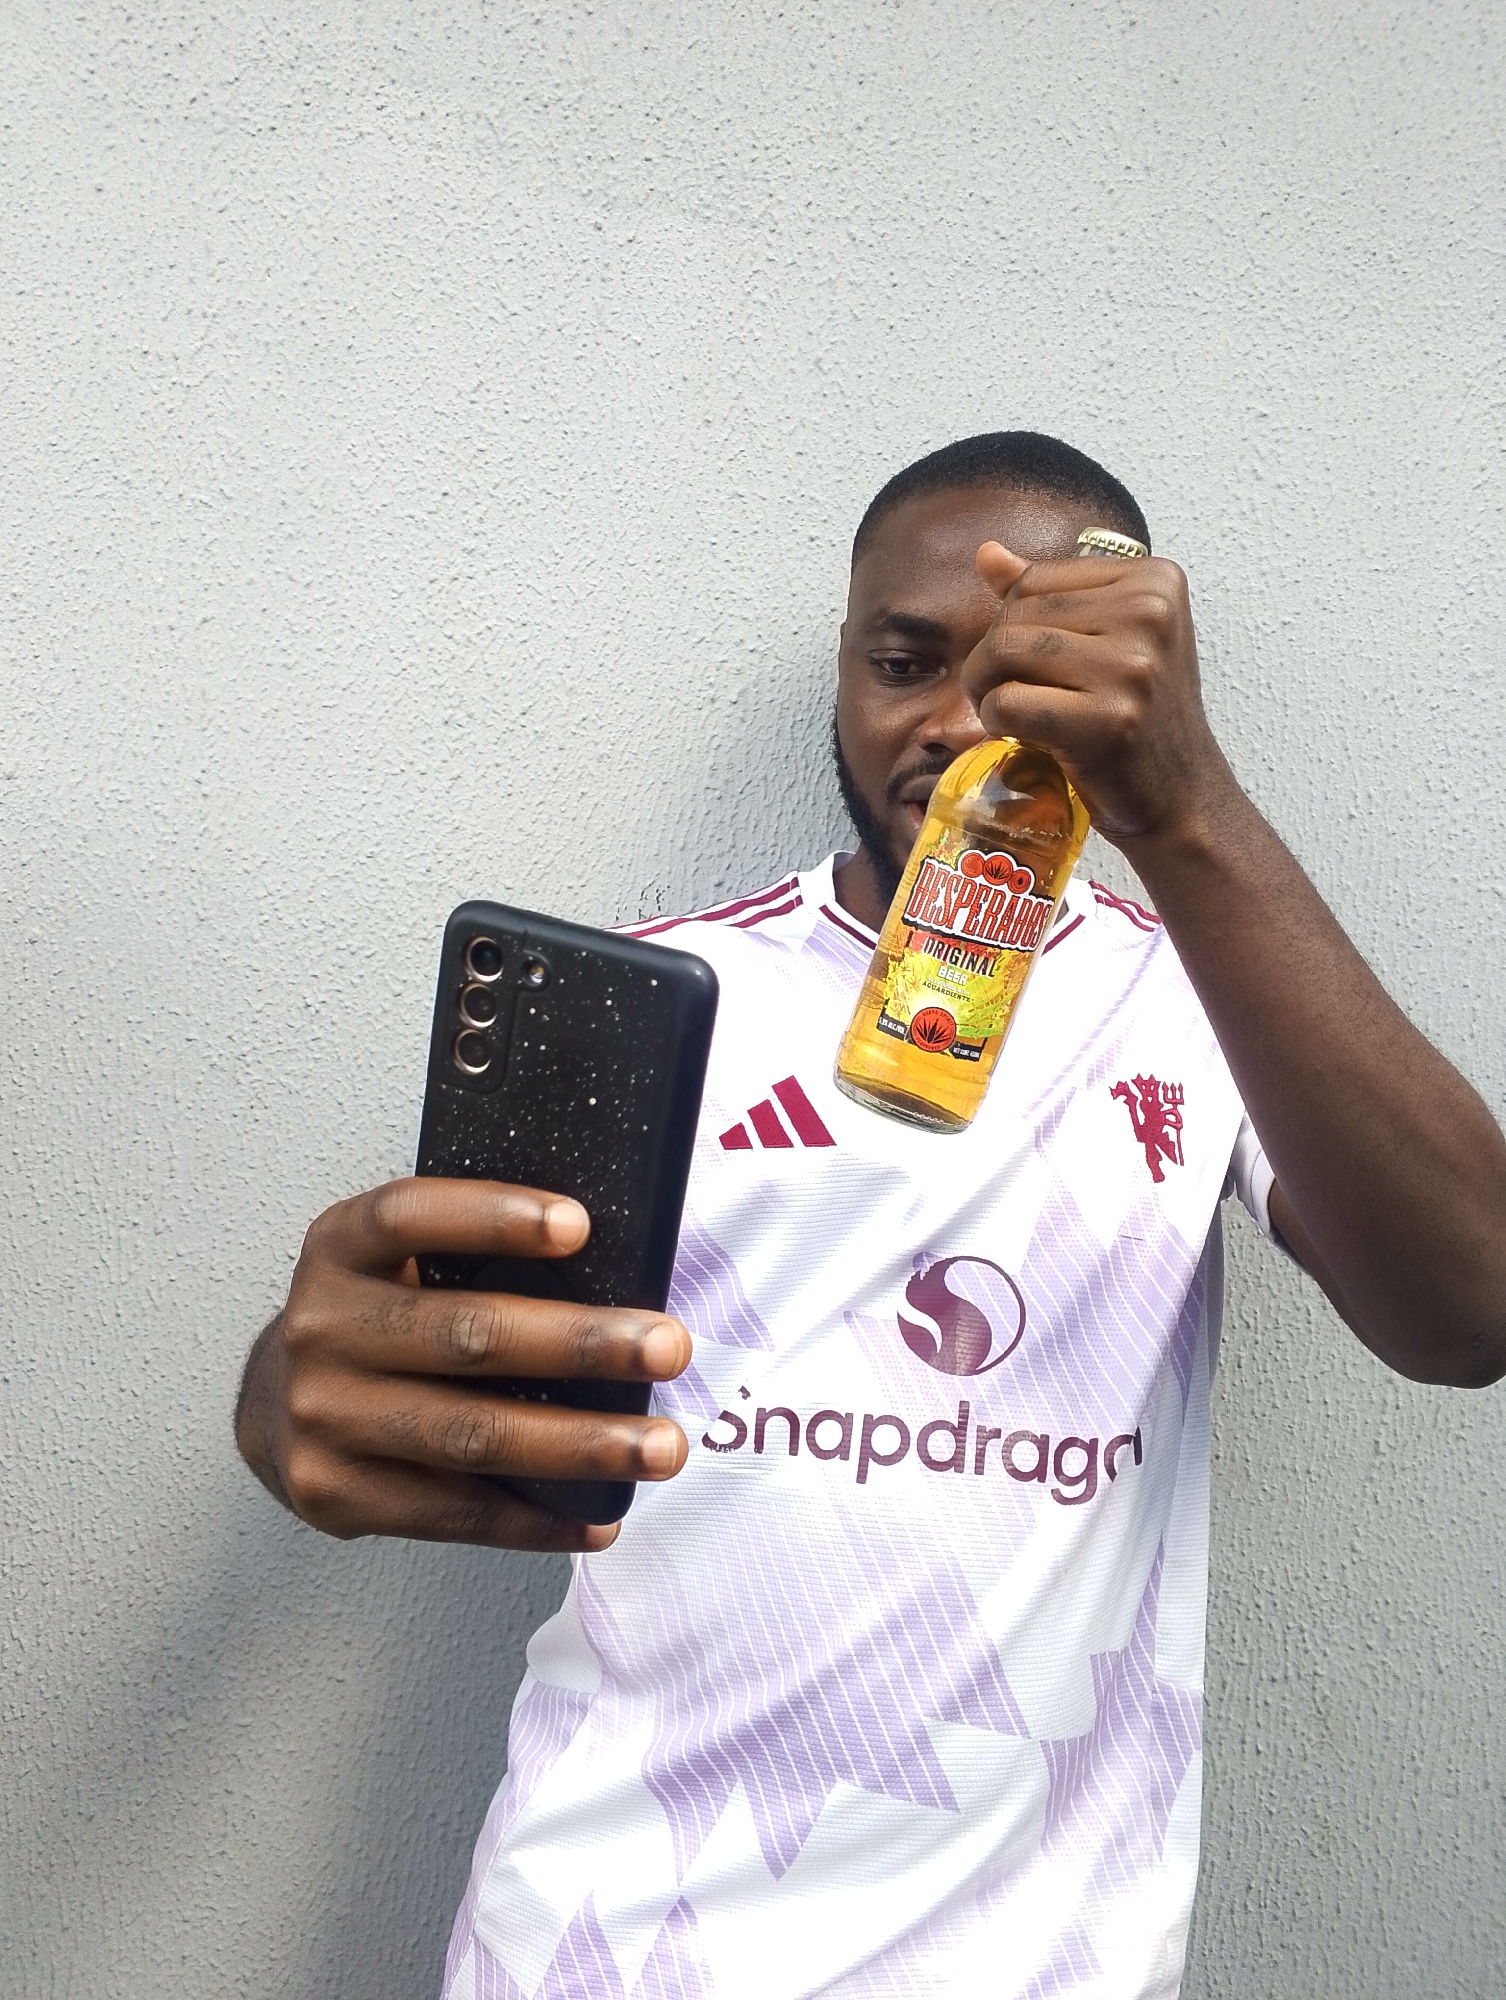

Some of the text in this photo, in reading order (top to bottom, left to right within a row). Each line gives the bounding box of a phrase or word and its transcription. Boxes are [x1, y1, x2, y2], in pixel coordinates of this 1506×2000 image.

[907, 861, 1053, 949] DESPERADOS
[921, 936, 996, 979] ORIGINAL
[937, 964, 968, 986] BEER
